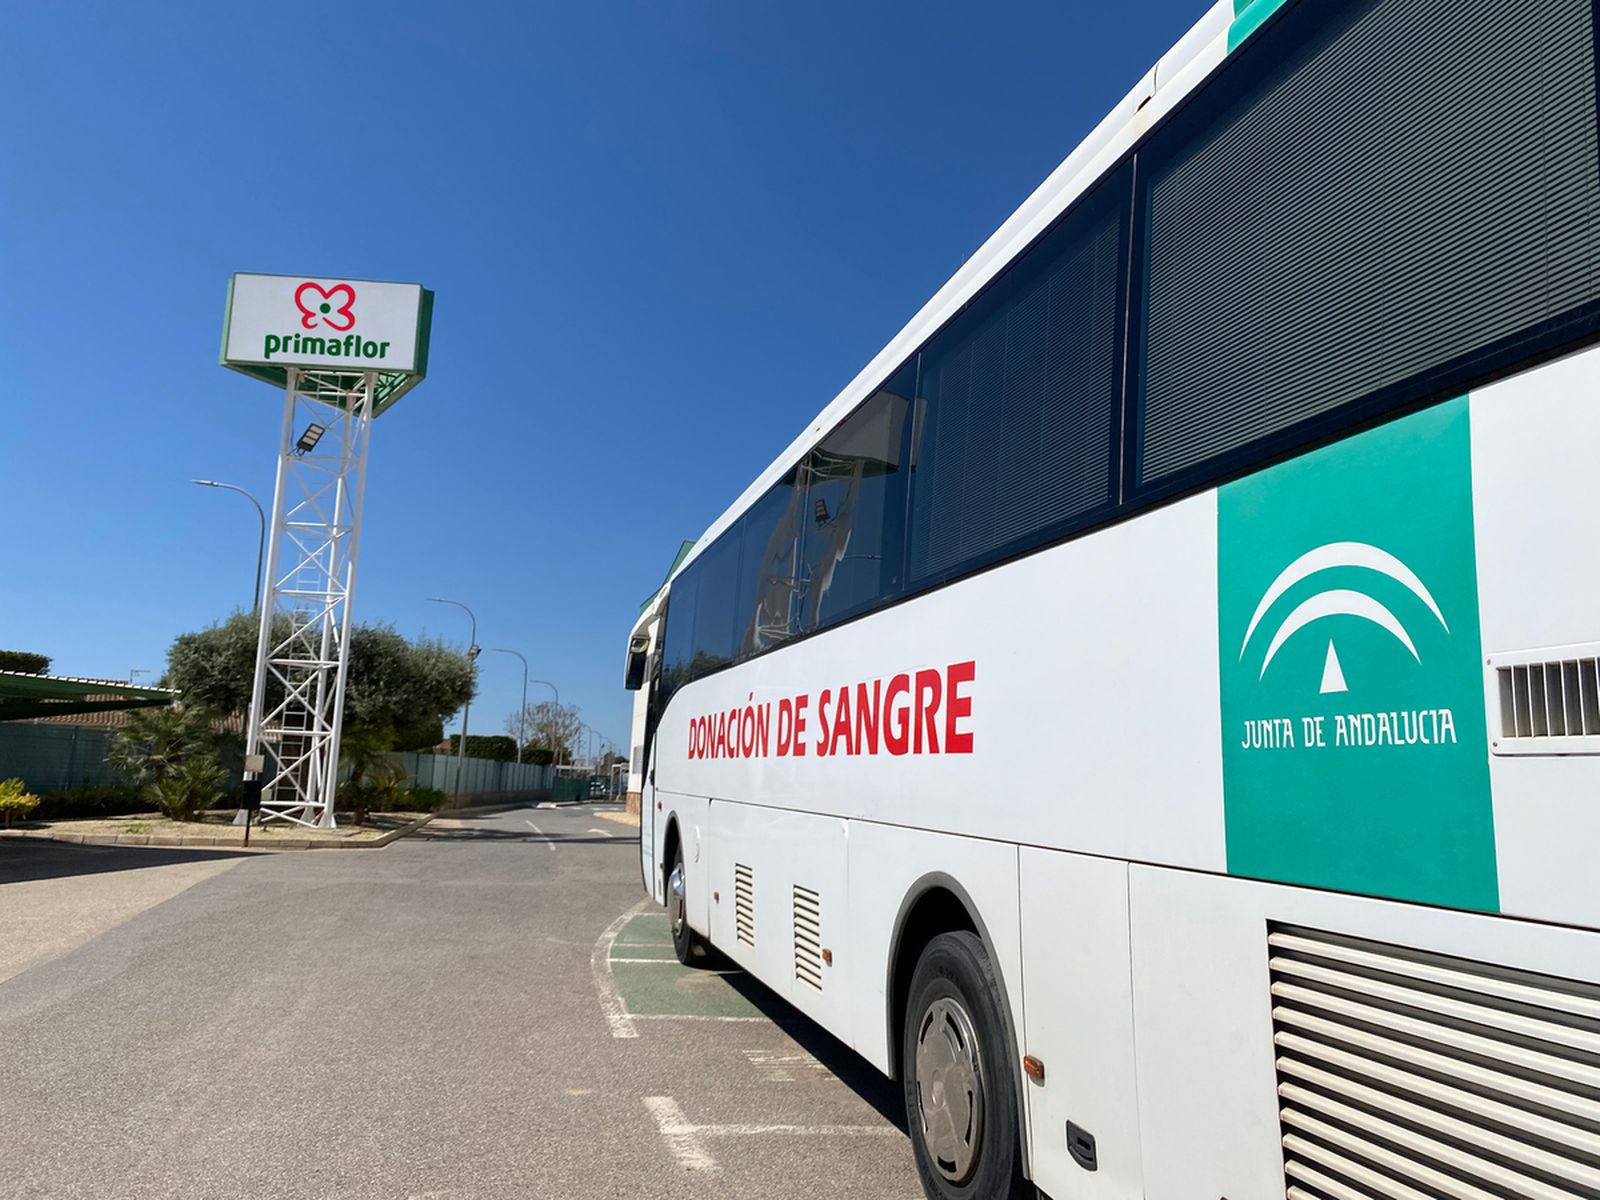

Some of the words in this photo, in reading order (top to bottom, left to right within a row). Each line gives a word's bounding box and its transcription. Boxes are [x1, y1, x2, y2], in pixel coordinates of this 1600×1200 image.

[264, 333, 390, 359] primaflor
[688, 692, 770, 759] DONACIÓN
[777, 695, 808, 757] DE
[816, 660, 975, 757] SANGRE
[1241, 719, 1294, 749] JUNTA
[1302, 716, 1326, 747] DE
[1335, 709, 1457, 746] ANDALUCIA
